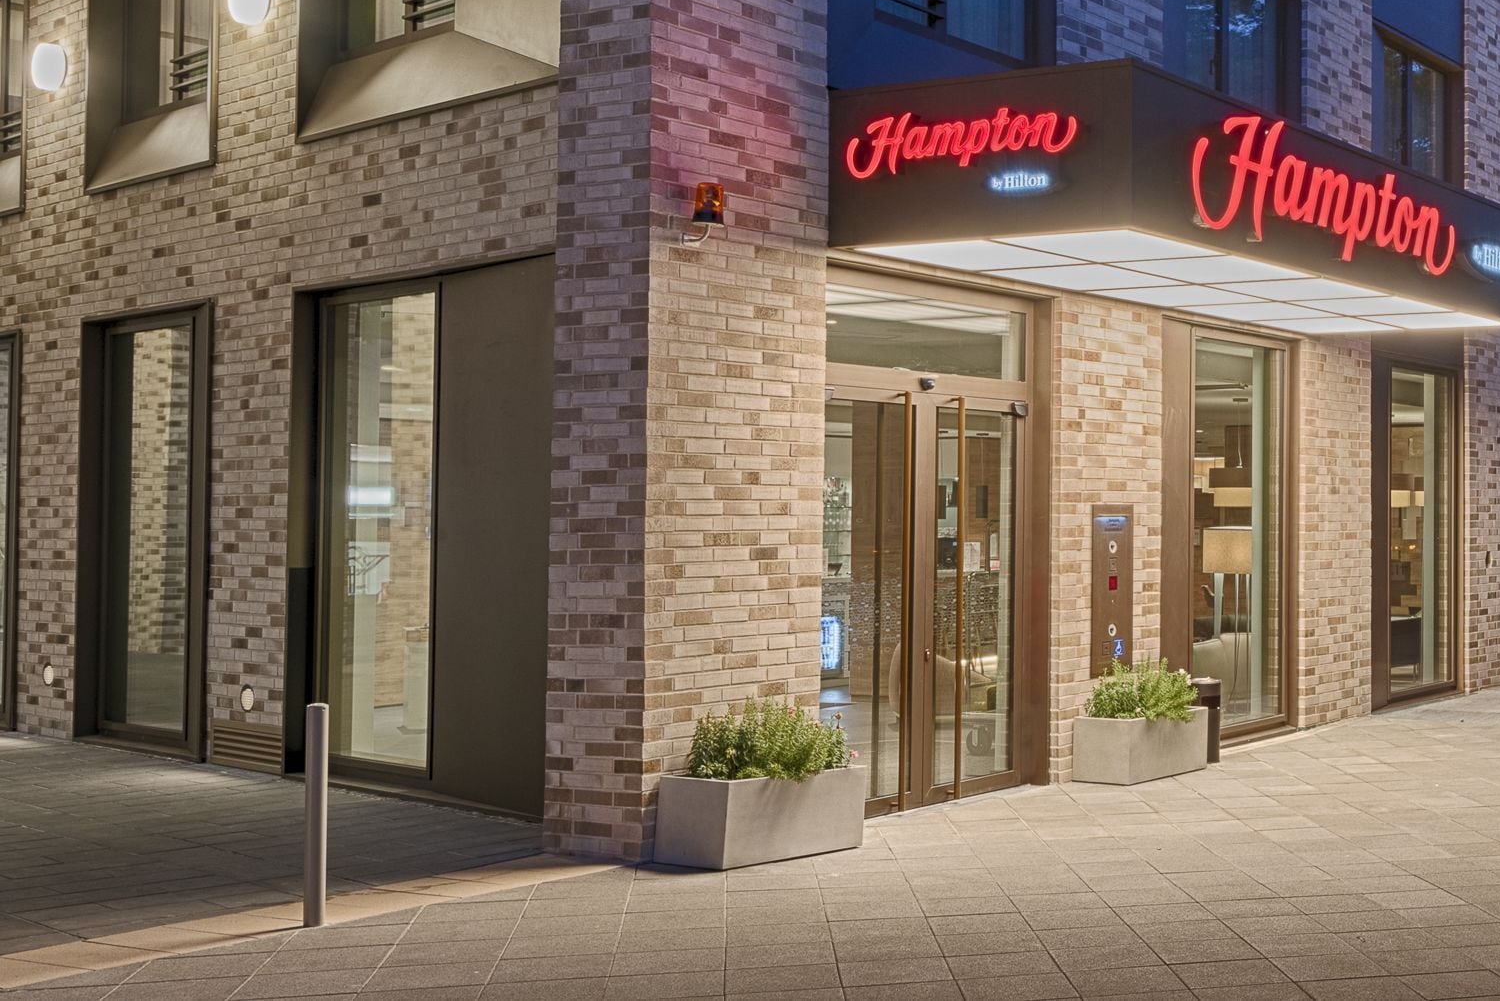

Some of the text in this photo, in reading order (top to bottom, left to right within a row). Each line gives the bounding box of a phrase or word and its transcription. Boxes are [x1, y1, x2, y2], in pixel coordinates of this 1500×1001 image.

[846, 107, 1078, 179] Hampton
[1004, 172, 1047, 189] Hilton
[1192, 116, 1456, 276] Hampton
